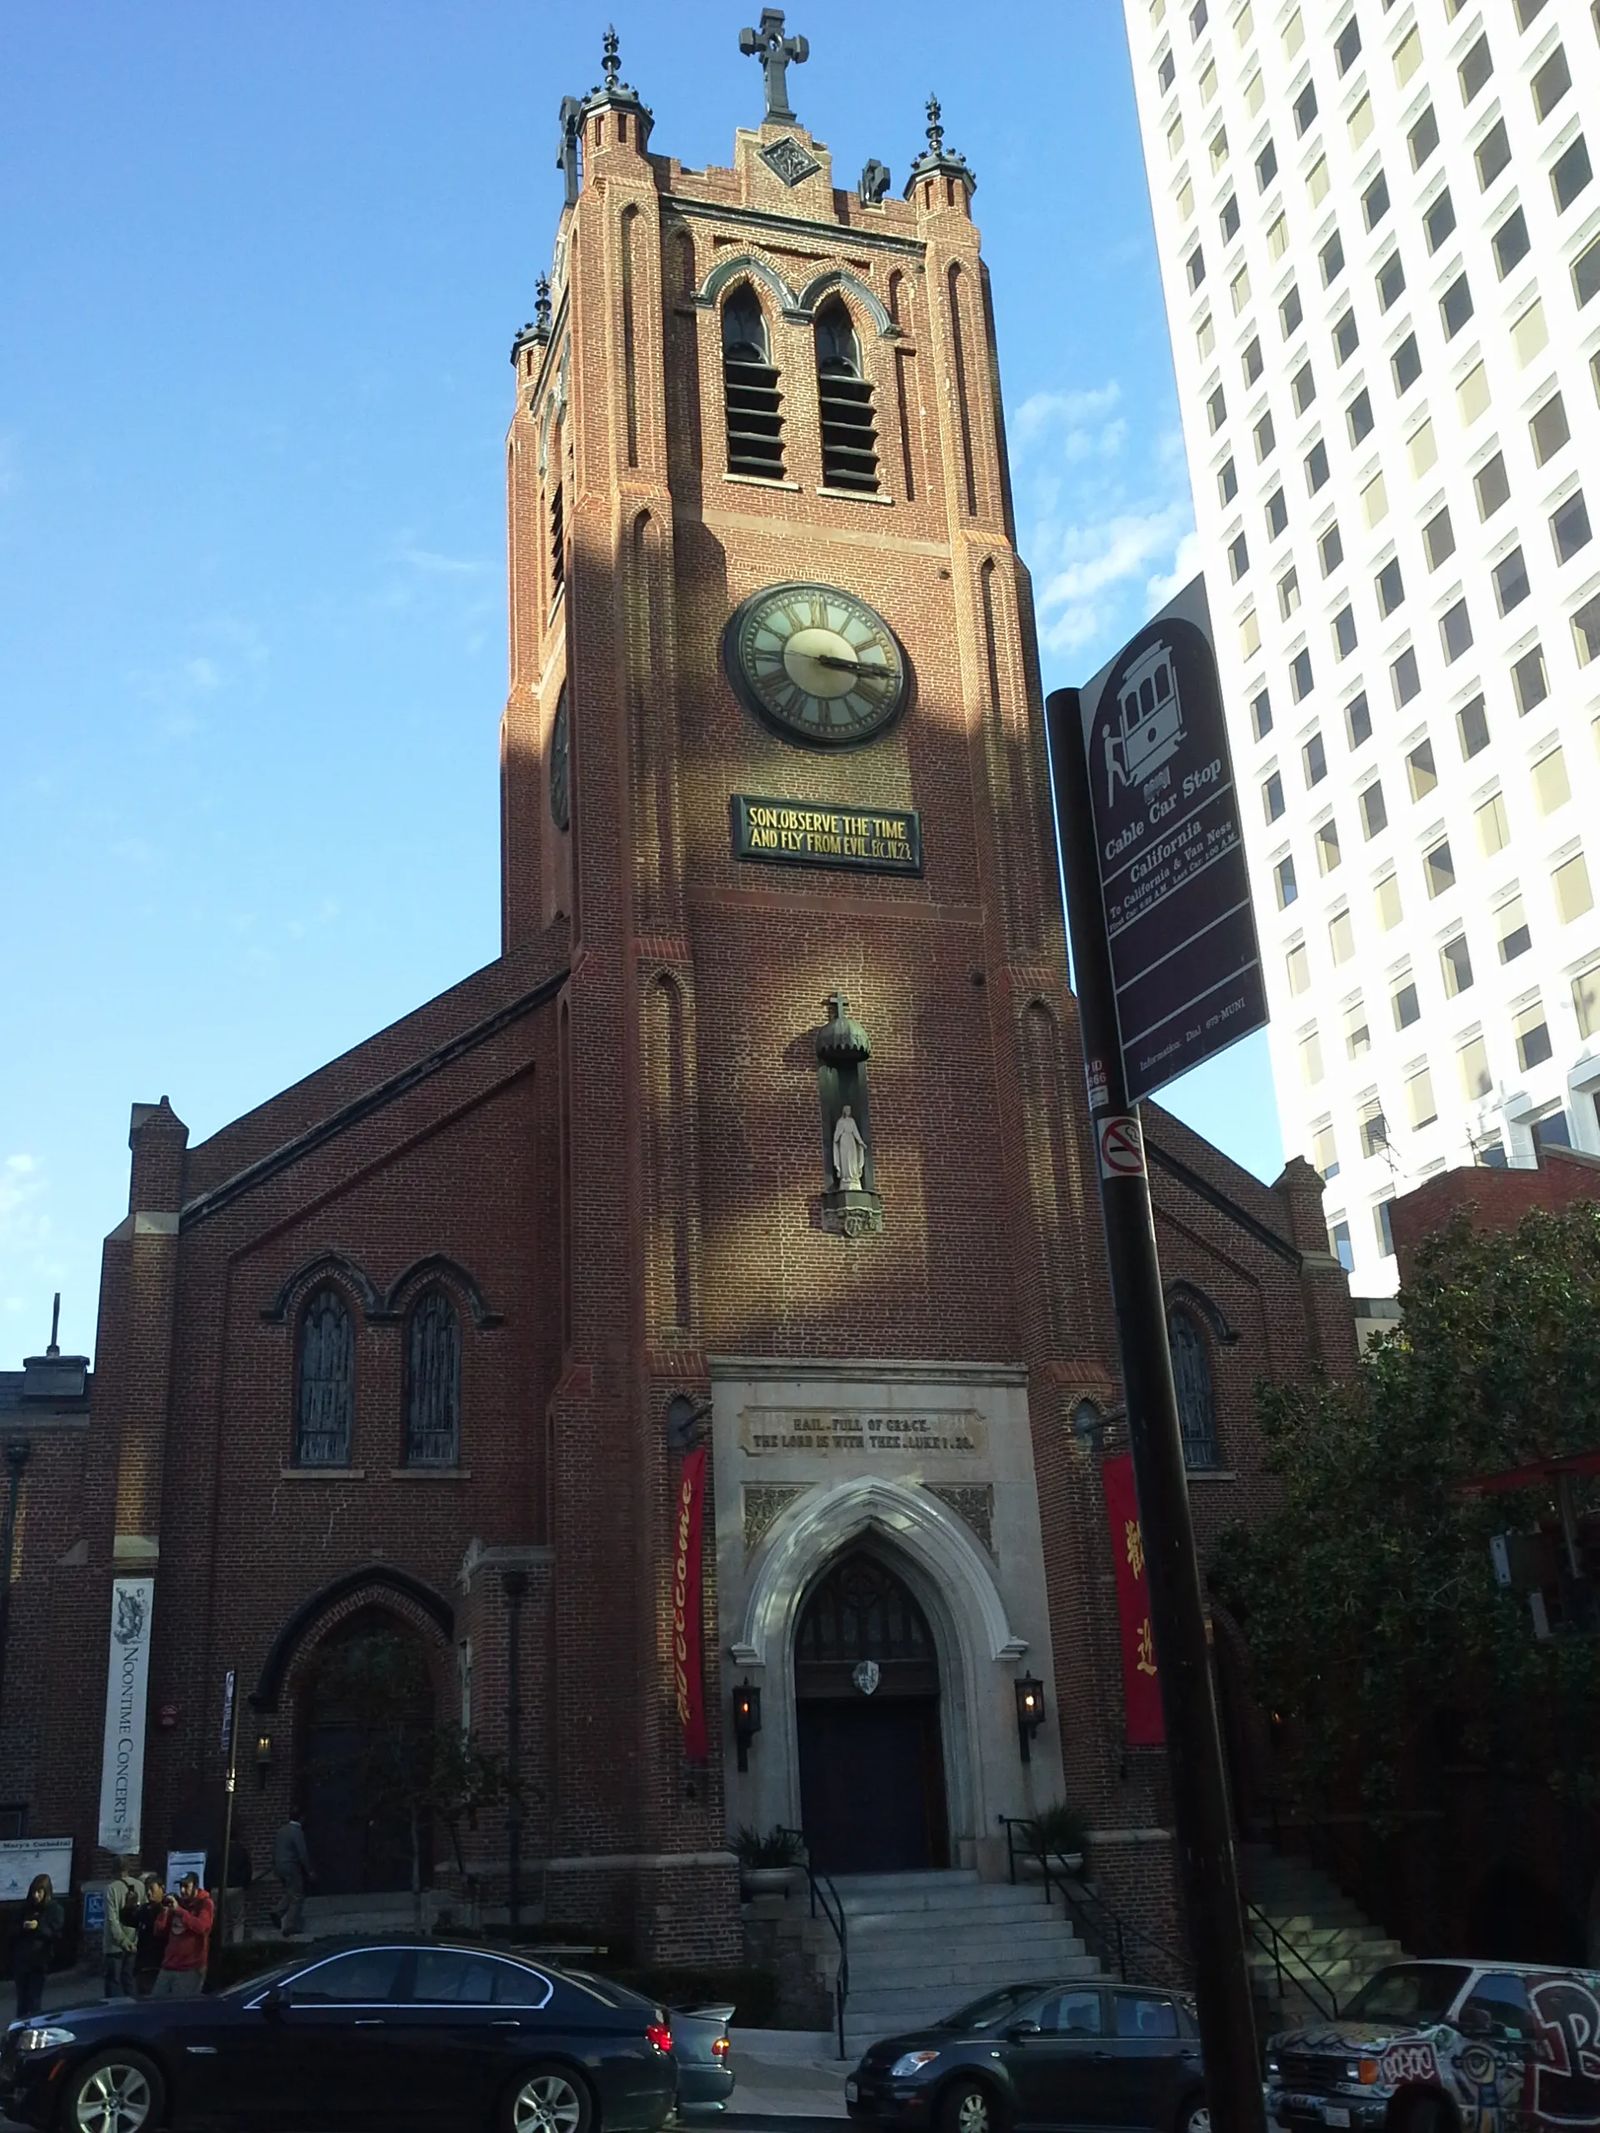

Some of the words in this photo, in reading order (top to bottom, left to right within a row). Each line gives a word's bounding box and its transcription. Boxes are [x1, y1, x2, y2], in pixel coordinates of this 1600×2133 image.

[751, 828, 778, 848] AND
[781, 831, 803, 850] FLY
[806, 833, 841, 854] FROM
[843, 816, 870, 836] THE
[873, 819, 907, 840] TIME
[1105, 820, 1144, 861] Cable
[1149, 792, 1178, 824] Car
[1182, 758, 1222, 799] Stop
[1109, 905, 1122, 920] To
[1124, 869, 1170, 908] California
[1173, 858, 1182, 870] &
[1184, 842, 1204, 861] Van
[1206, 820, 1232, 844] Ness
[1130, 820, 1202, 883] California
[753, 1434, 778, 1448] THE
[782, 1435, 813, 1448] LORD
[832, 1435, 864, 1448] WITH
[832, 1418, 863, 1431] FULL
[868, 1418, 883, 1431] OF
[119, 1646, 140, 1733] NOONTIME
[112, 1737, 134, 1824] CONCERTS
